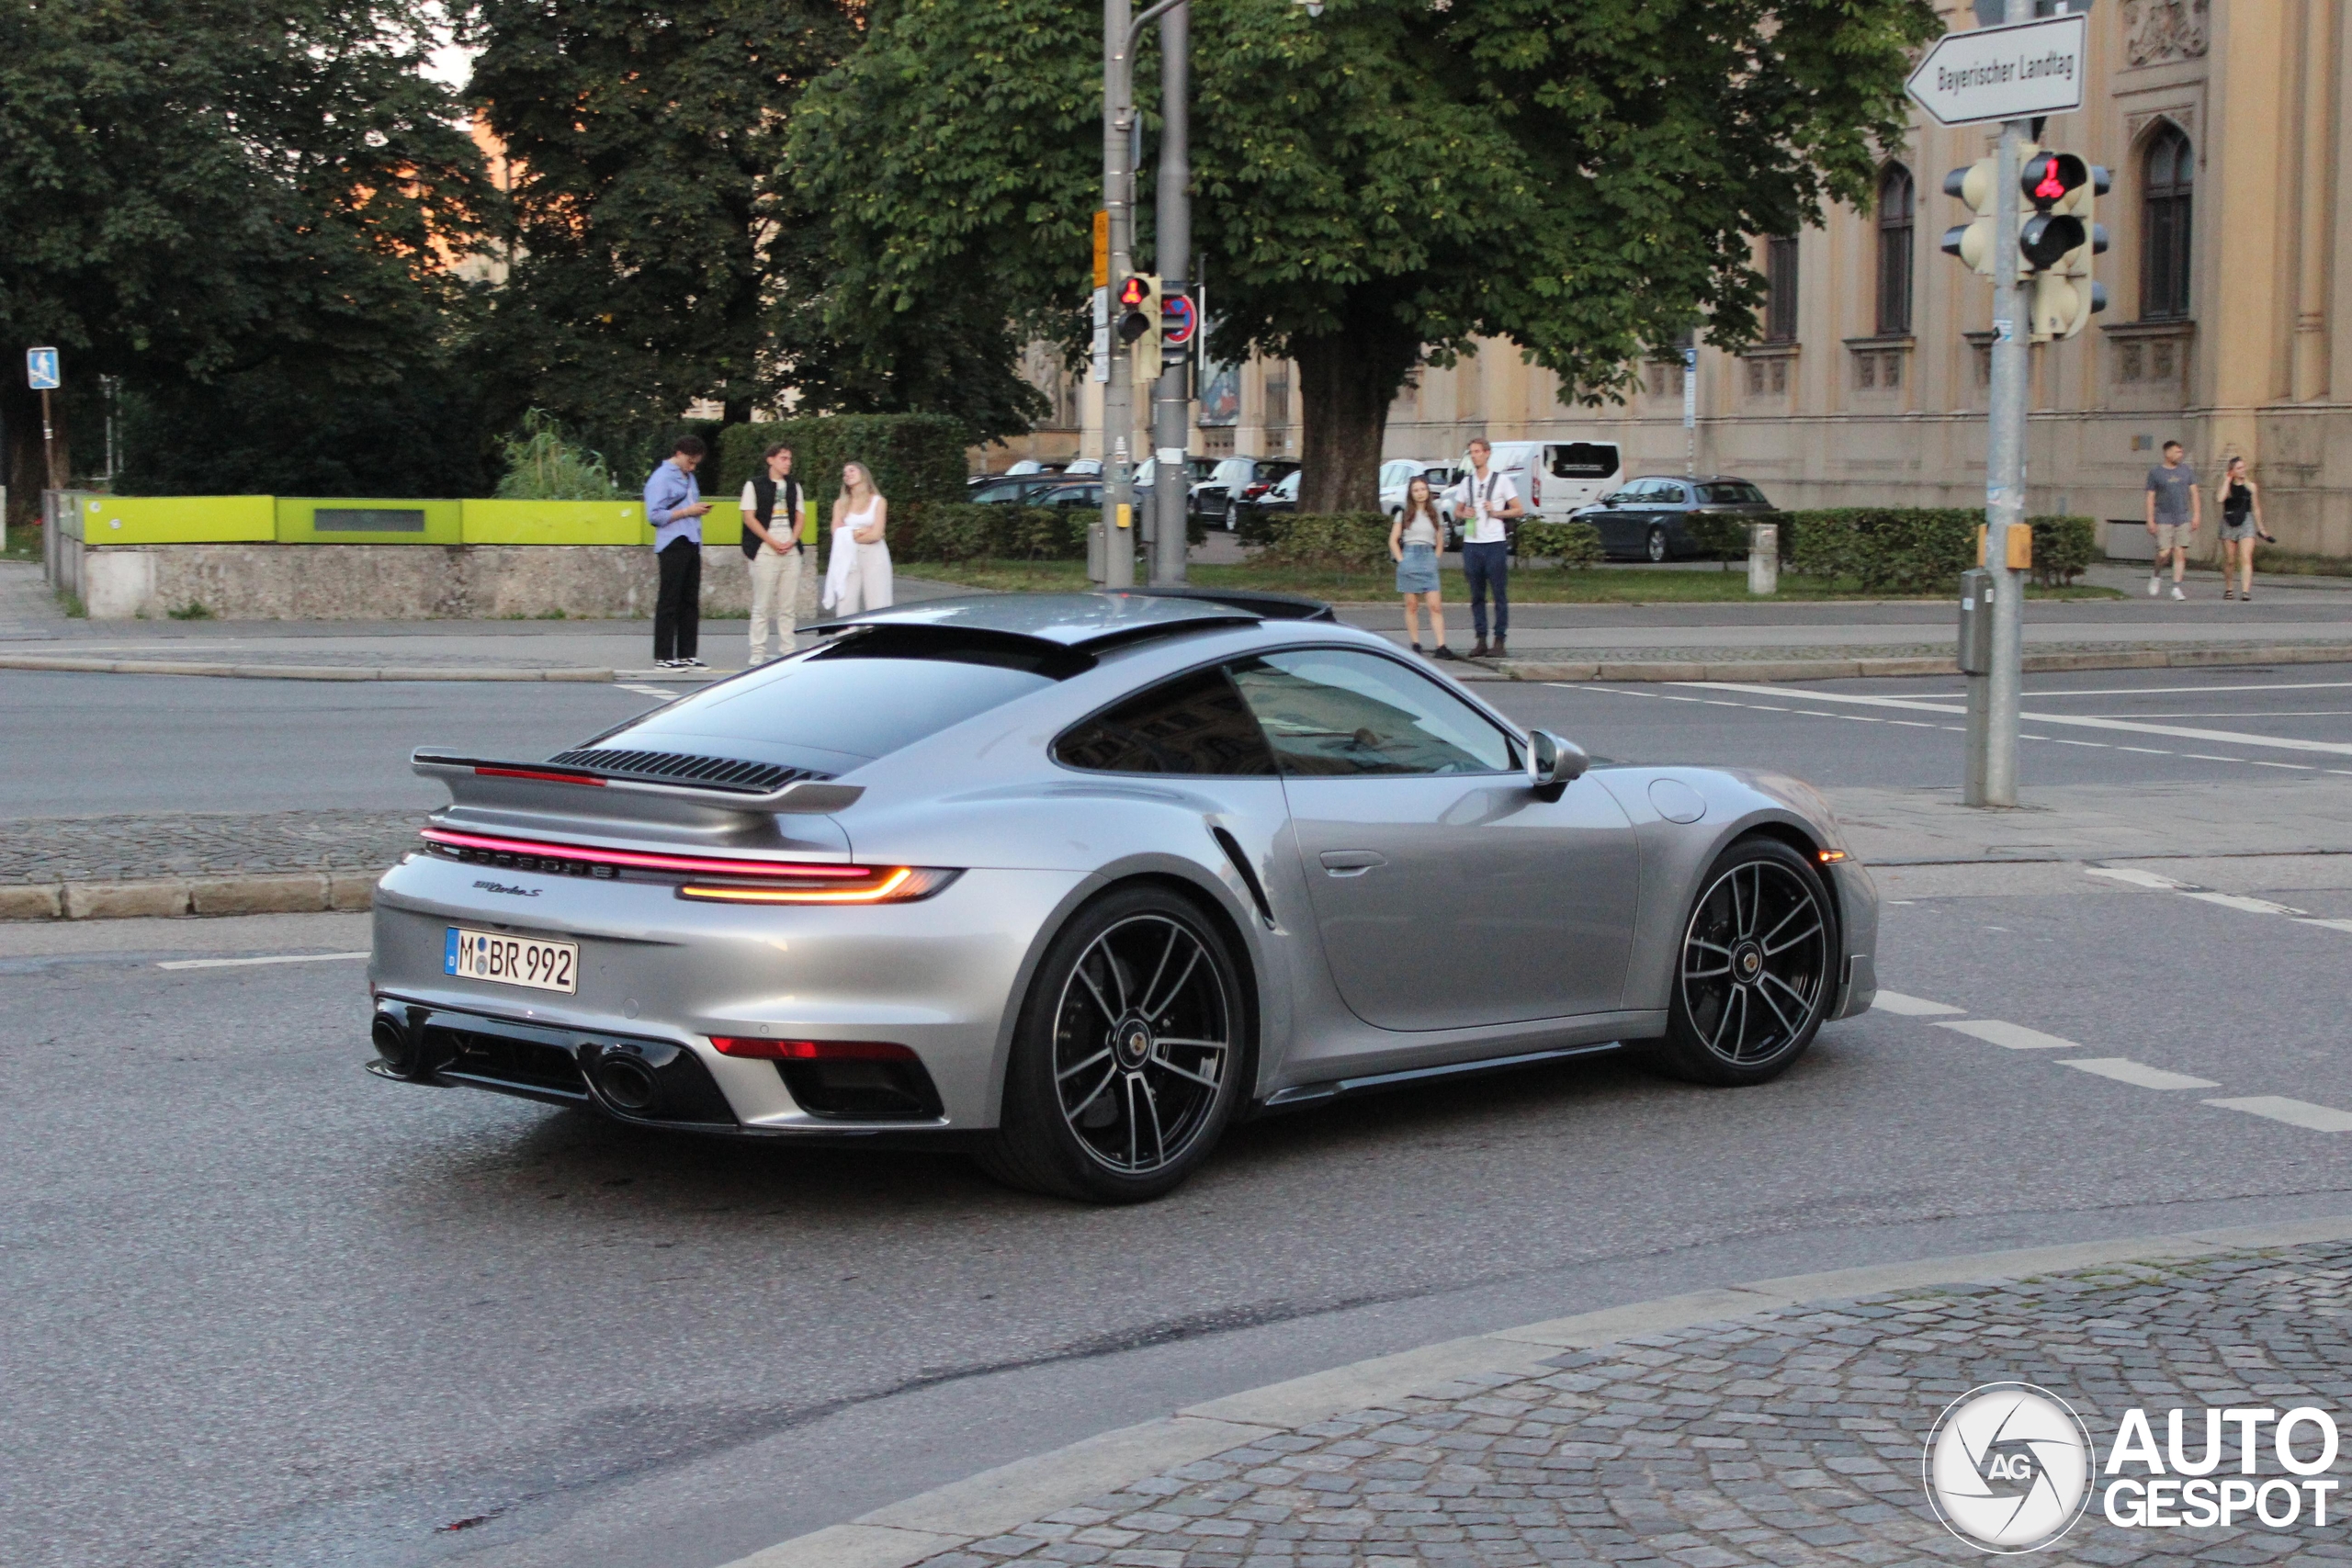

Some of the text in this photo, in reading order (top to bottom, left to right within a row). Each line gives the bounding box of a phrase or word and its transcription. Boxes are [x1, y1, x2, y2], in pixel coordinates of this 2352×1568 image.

[1937, 50, 2074, 96] Bayerischer Landtag
[459, 935, 571, 986] M BR 992
